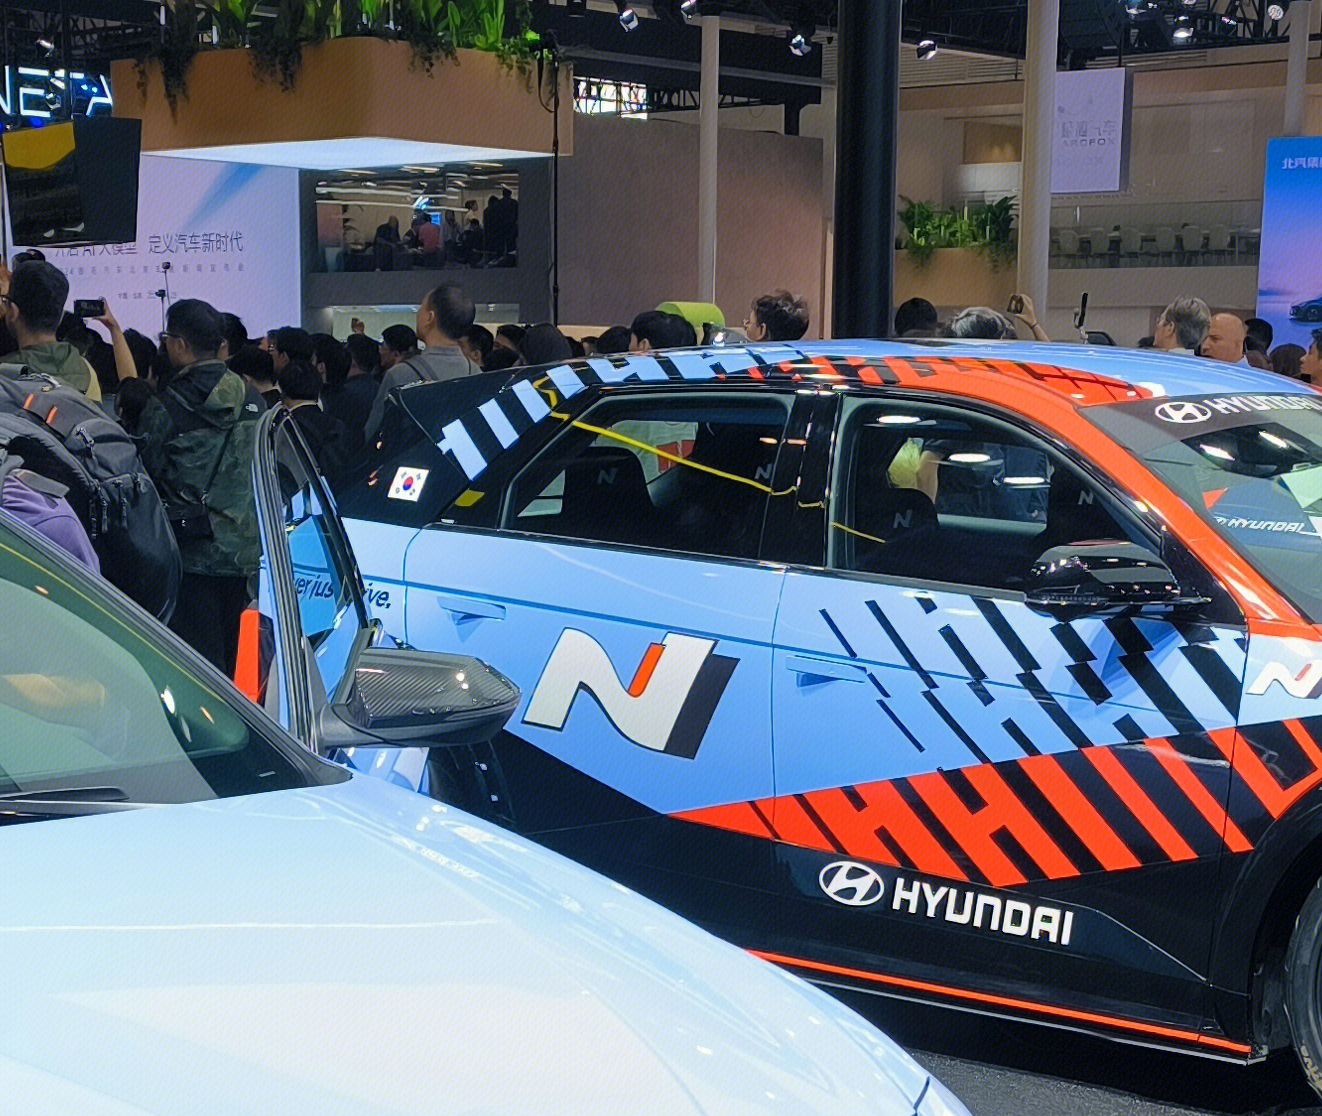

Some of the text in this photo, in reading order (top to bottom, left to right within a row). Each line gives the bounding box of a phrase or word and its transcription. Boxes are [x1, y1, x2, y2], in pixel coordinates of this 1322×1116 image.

[148, 231, 245, 254] 定义汽车新时代
[1227, 517, 1305, 533] HYUNDAI
[309, 575, 333, 600] jus
[521, 627, 740, 759] N
[892, 877, 1074, 945] HYUNDAI
